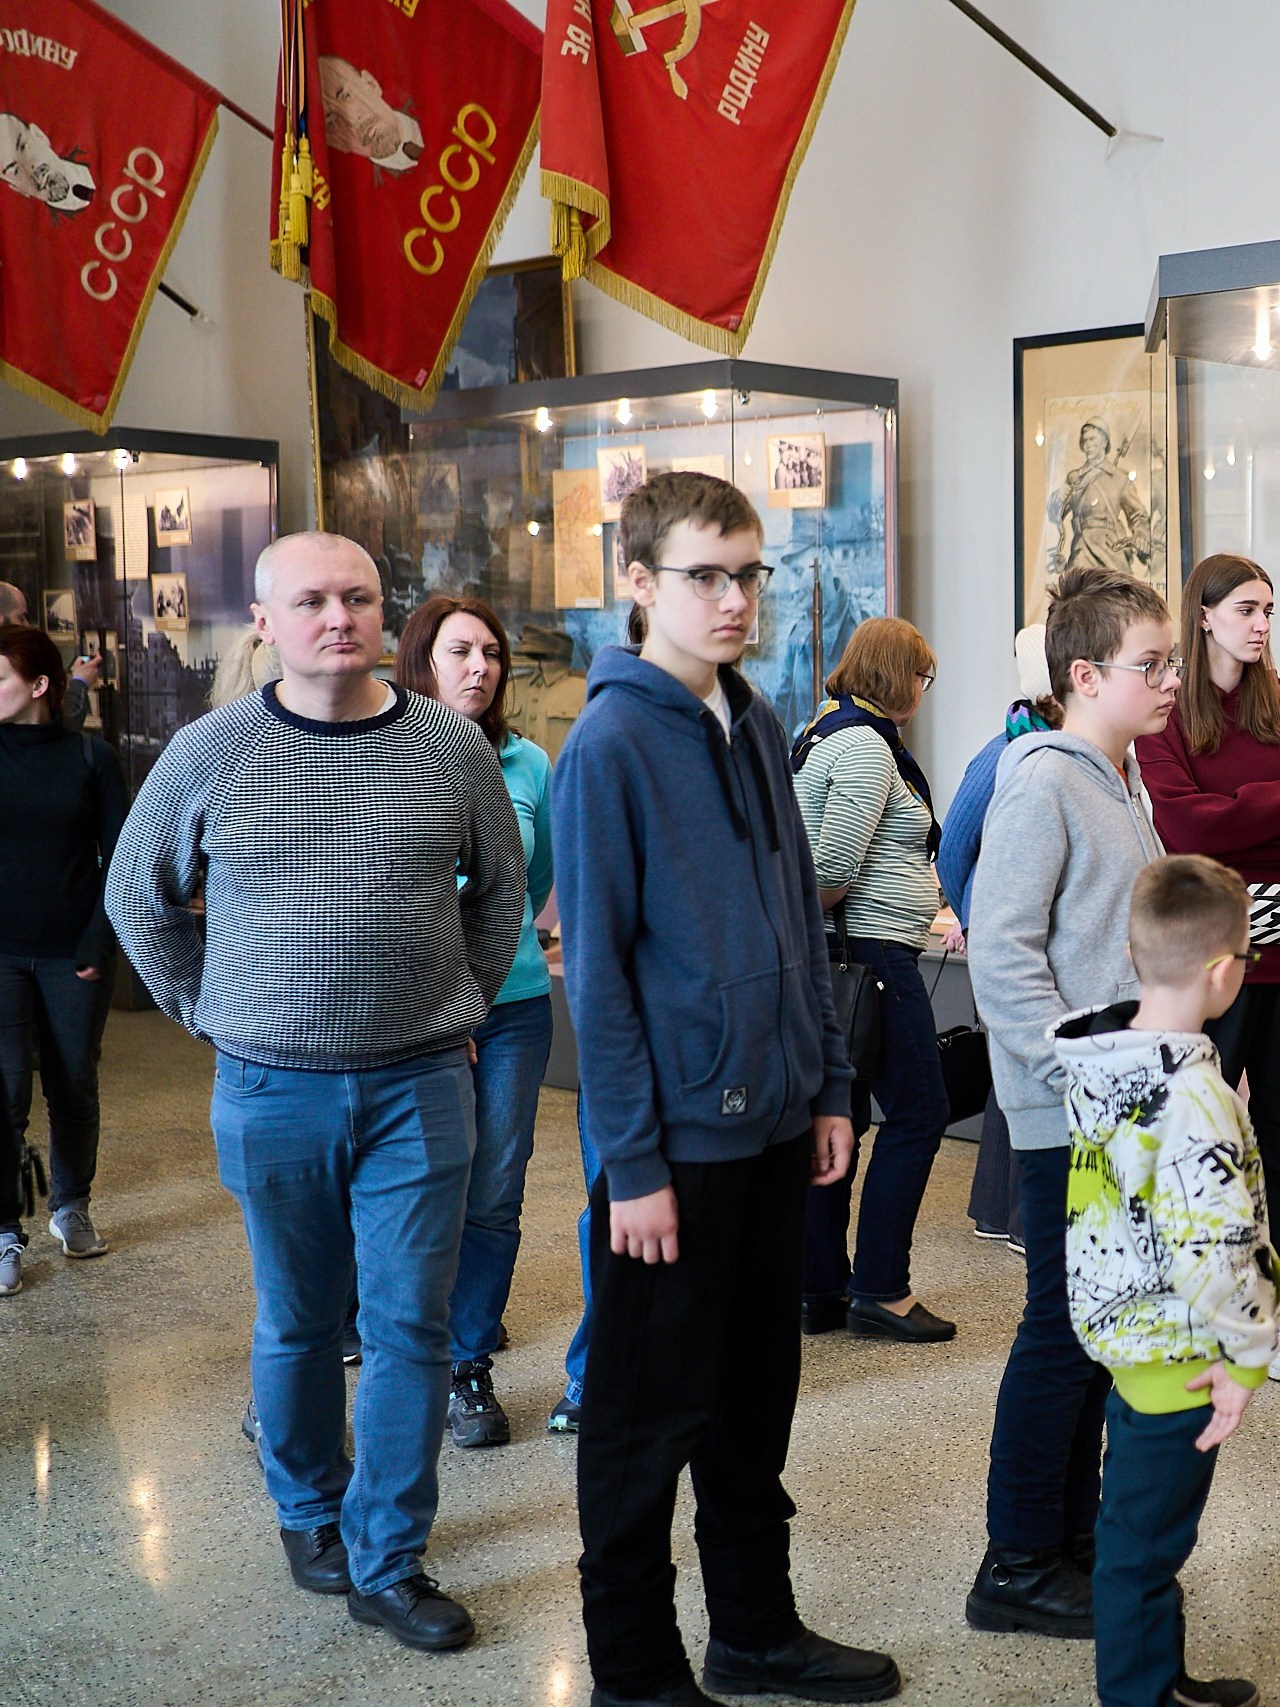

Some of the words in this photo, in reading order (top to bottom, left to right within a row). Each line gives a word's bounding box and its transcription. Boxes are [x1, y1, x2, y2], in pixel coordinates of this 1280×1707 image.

[0, 28, 78, 70] ОДИНУ
[560, 24, 591, 64] ЗА
[716, 20, 770, 126] РОДИНУ
[81, 147, 166, 301] СССР
[403, 103, 497, 275] СССР
